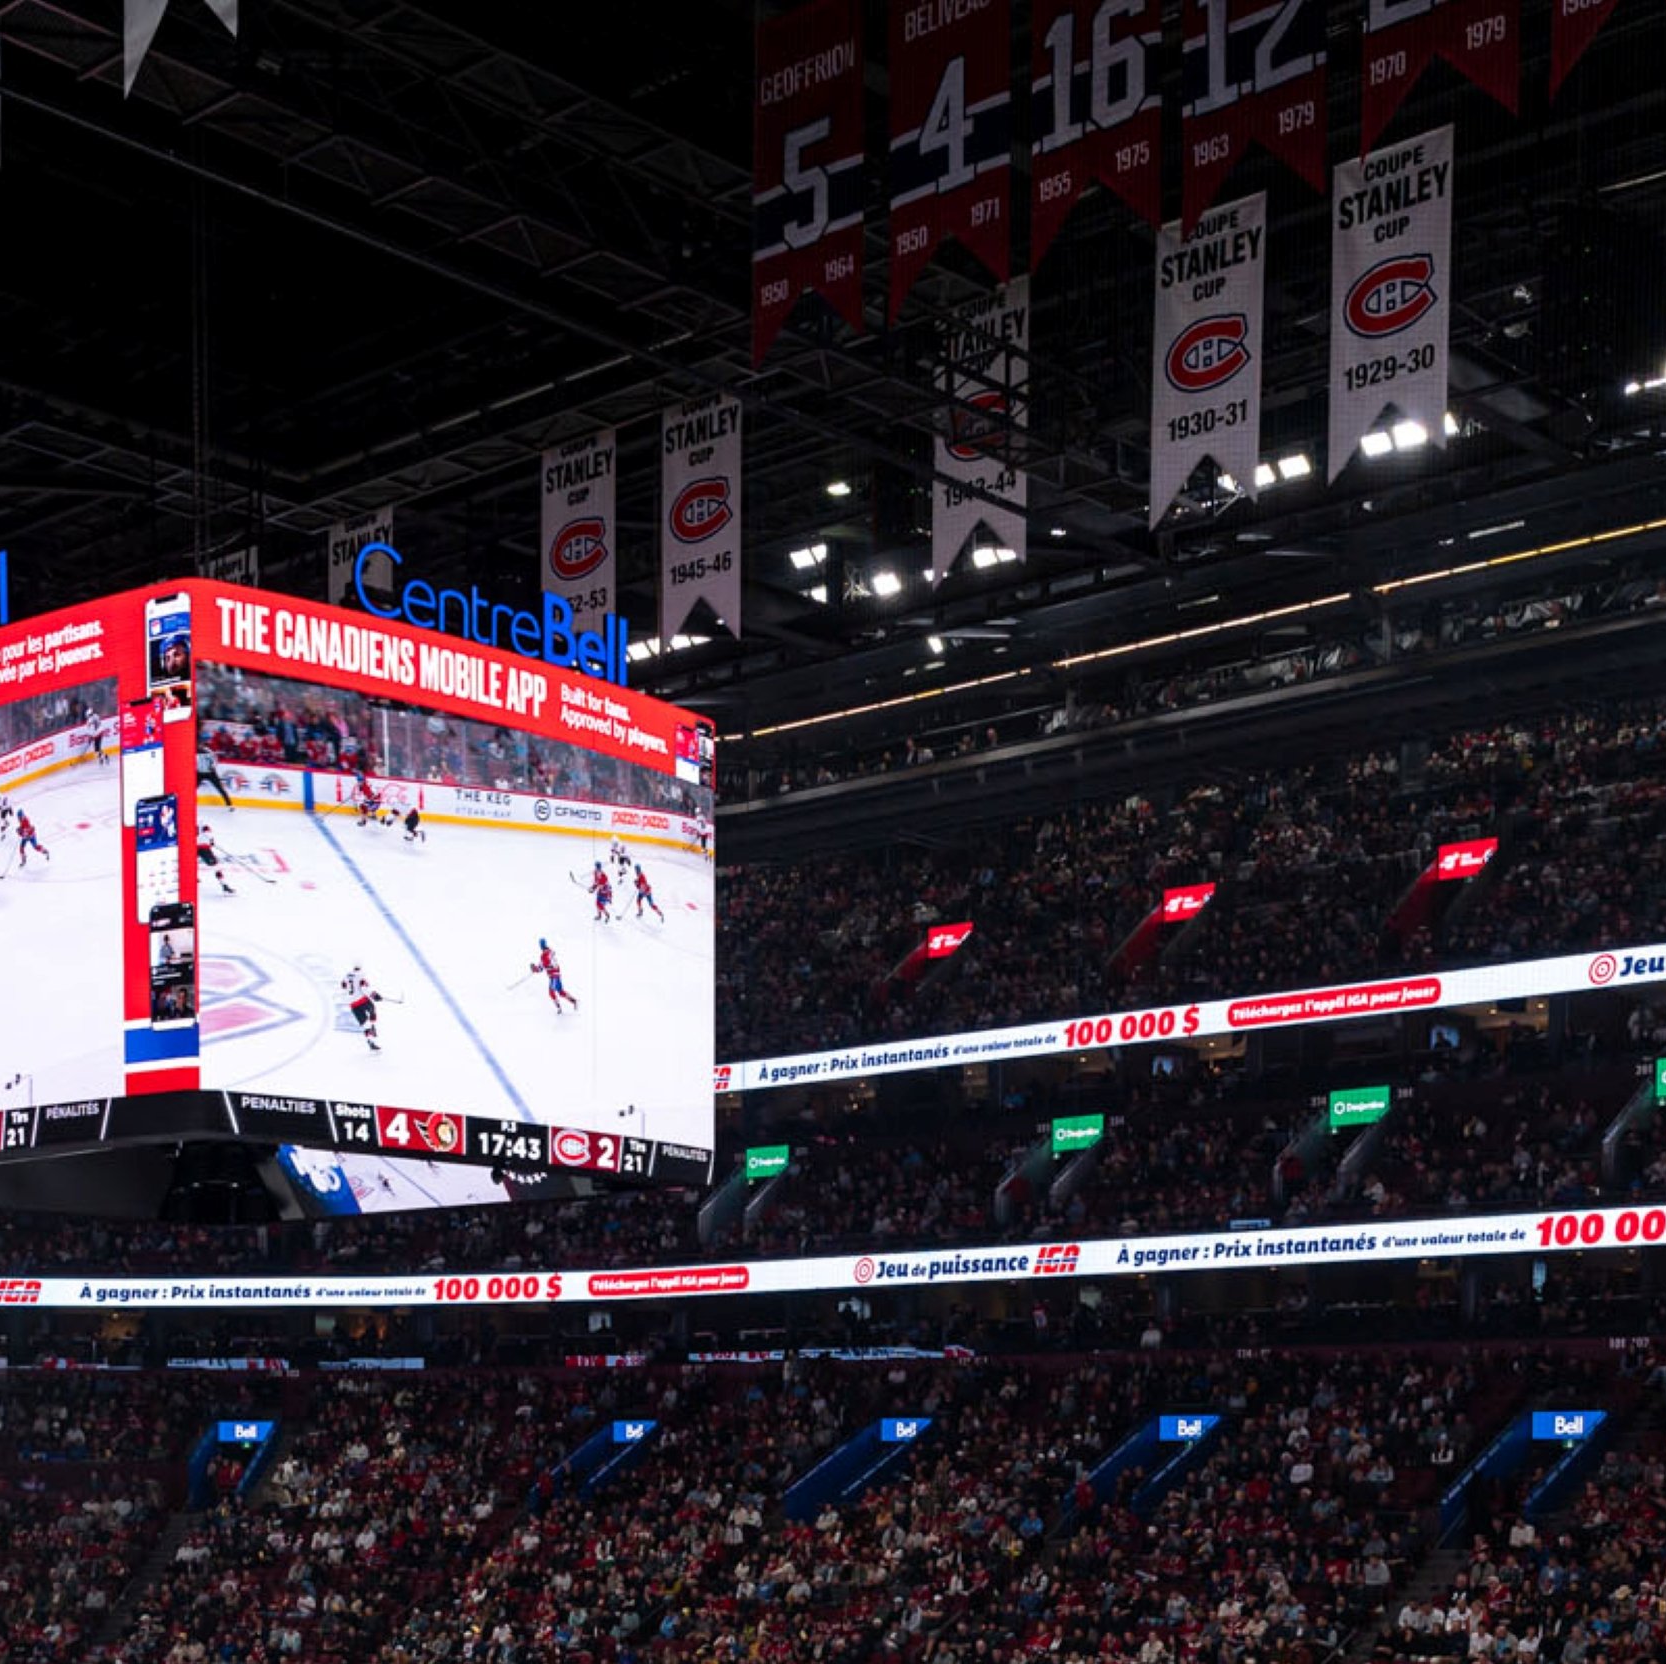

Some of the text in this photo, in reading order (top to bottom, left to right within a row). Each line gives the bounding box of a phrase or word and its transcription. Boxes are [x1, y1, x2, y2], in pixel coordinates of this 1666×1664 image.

[1465, 15, 1506, 51] 1979
[760, 40, 856, 106] GEOFFRION
[1039, 0, 1148, 155] 16
[1369, 51, 1407, 85] 1970
[918, 54, 975, 195] 4
[1278, 103, 1316, 137] 1979
[1115, 143, 1151, 173] 1975
[1192, 135, 1230, 168] 1963
[1363, 144, 1424, 182] COUPE
[782, 115, 832, 249] 5
[1038, 172, 1072, 201] 1955
[1338, 161, 1449, 230] STANLEY
[969, 197, 1001, 228] 1971
[896, 227, 928, 256] 1950
[1374, 216, 1410, 243] CUP
[824, 255, 855, 284] 1964
[1160, 227, 1262, 288] STANLEY
[759, 280, 790, 307] 1950
[1193, 276, 1227, 301] CUP
[1345, 344, 1436, 391] 1929-30
[664, 405, 740, 457] STANLEY
[1168, 399, 1249, 442] 1930-31
[545, 446, 613, 496] STANLEY
[669, 552, 732, 586] 1945-46
[1, 641, 24, 664] pour
[216, 599, 547, 718] THE CANADIENS MOBILE APP
[561, 682, 584, 707] Built
[585, 688, 602, 710] for
[561, 703, 613, 738] Approved
[627, 724, 669, 756] players.
[1619, 955, 1665, 978] Jeu
[861, 1012, 1175, 1069] instantanés 100 000
[46, 1101, 99, 1121] PÉNALITÉS
[242, 1095, 316, 1116] PENALTIES
[344, 1121, 369, 1142] 14
[386, 1113, 409, 1145] 4
[478, 1133, 542, 1160] 17:43
[597, 1138, 614, 1168] 2
[1214, 1240, 1252, 1260] Prix
[1256, 1233, 1376, 1256] instantanés
[1536, 1214, 1604, 1247] 100
[929, 1253, 1029, 1281] puissance
